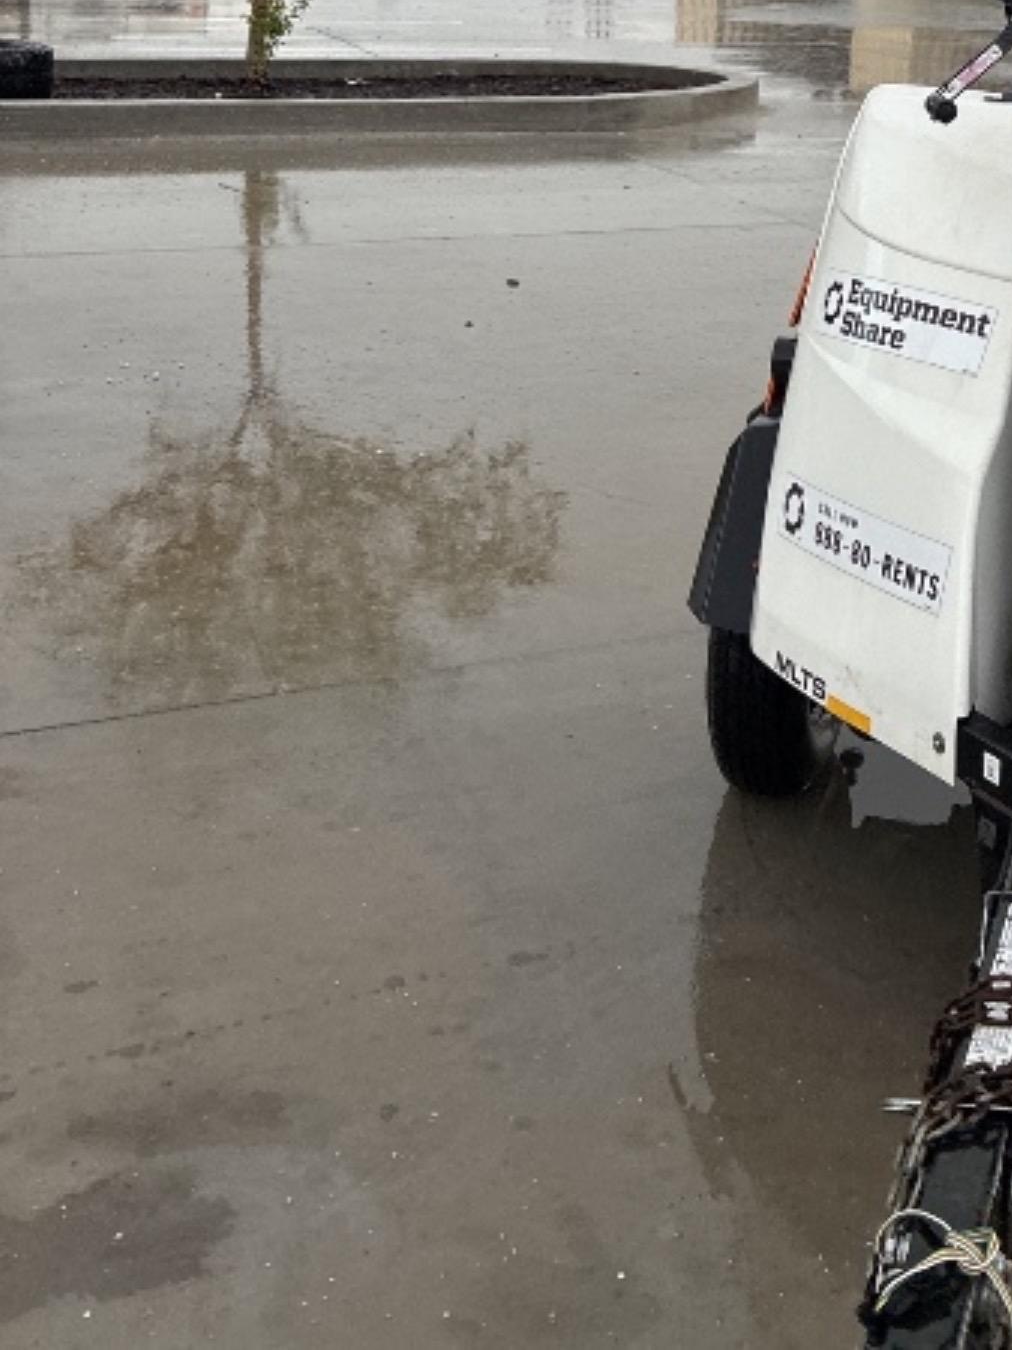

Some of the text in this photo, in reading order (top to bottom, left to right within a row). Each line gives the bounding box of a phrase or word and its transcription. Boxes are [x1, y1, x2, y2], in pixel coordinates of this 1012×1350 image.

[840, 311, 906, 349] Share
[848, 278, 991, 338] Equipment
[775, 651, 826, 700] MLTS
